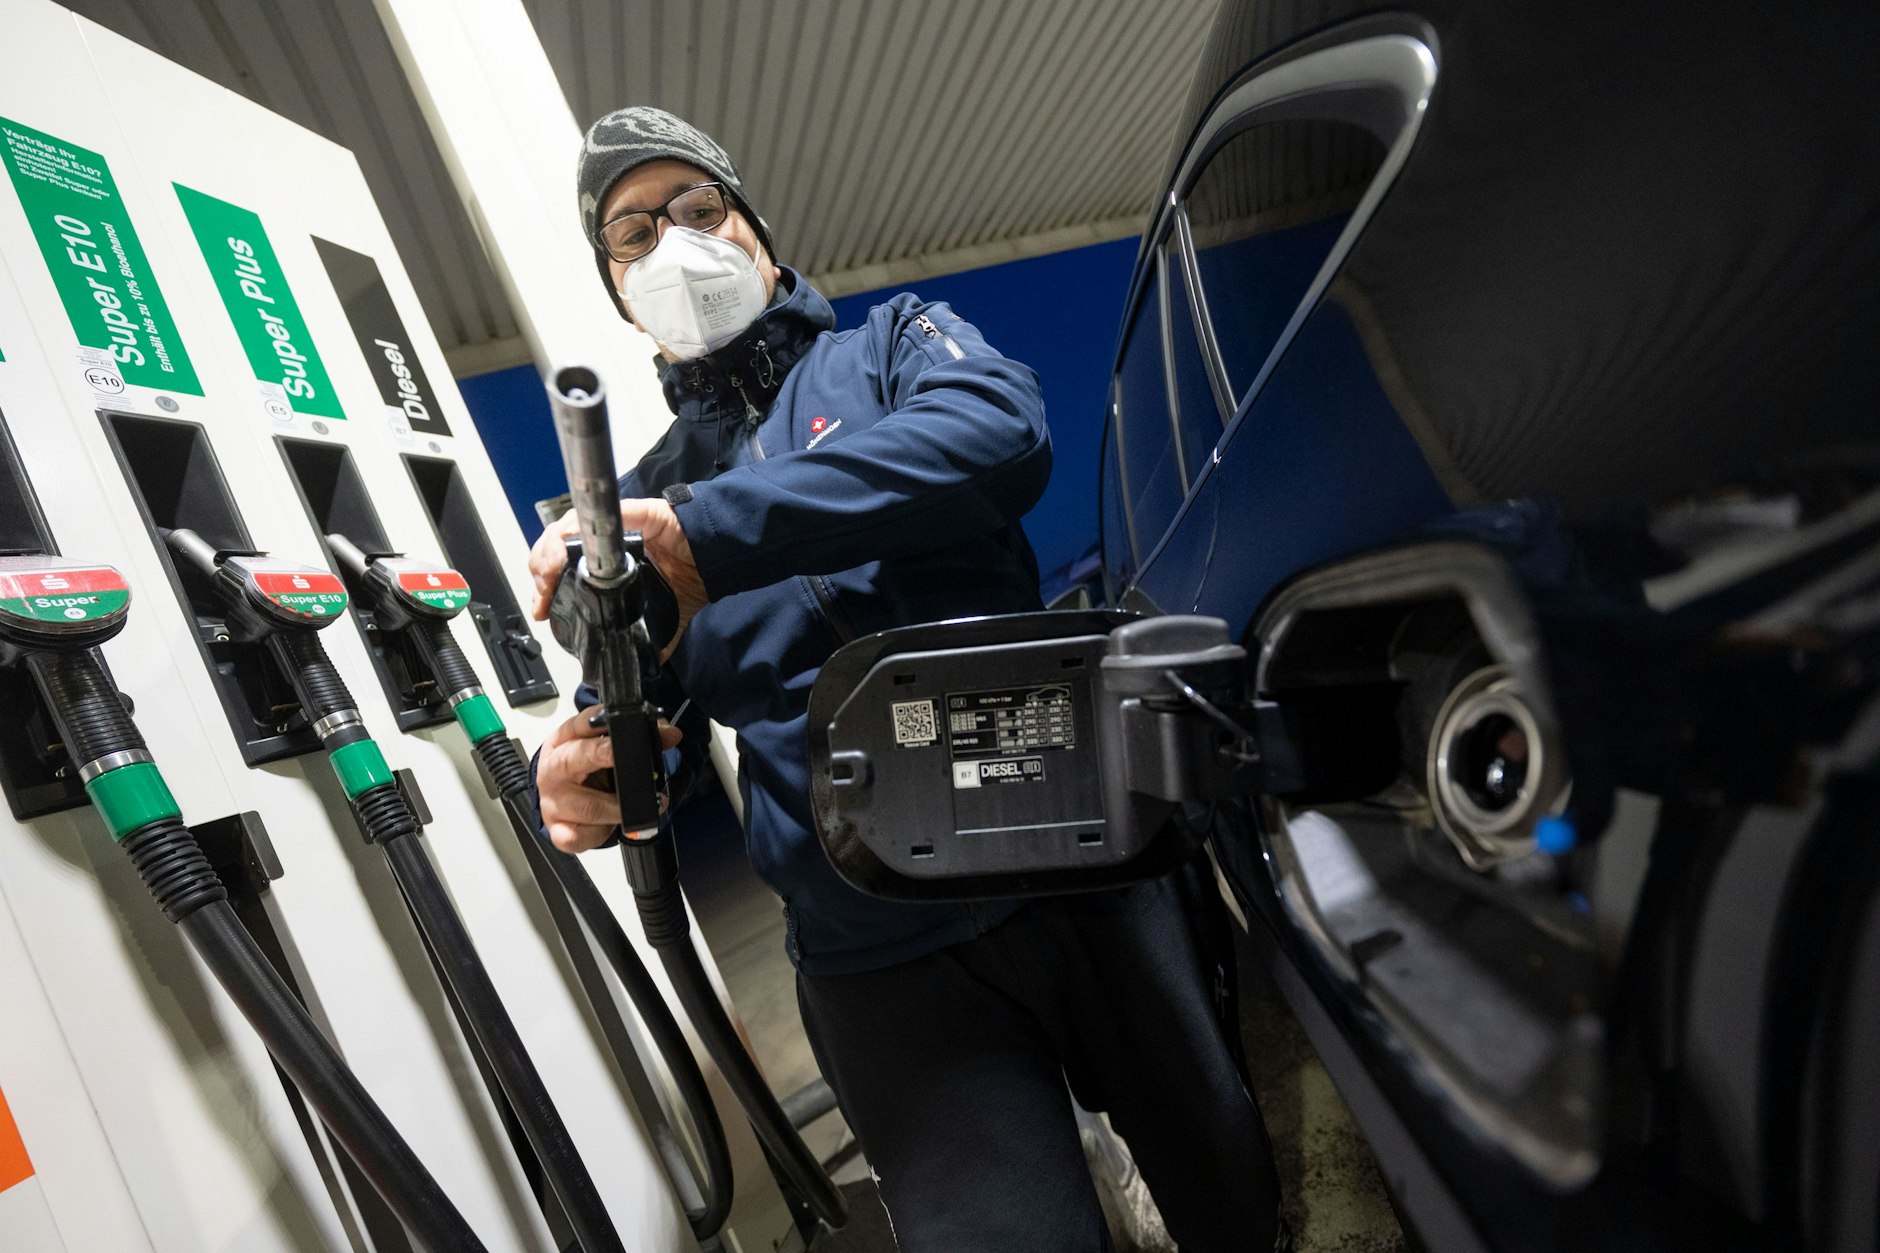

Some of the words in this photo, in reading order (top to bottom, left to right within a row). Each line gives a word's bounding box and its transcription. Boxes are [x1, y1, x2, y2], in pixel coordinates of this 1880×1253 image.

[2, 127, 57, 153] Verträgt
[59, 148, 76, 160] Ihr
[7, 137, 69, 167] Fahrzeug
[71, 161, 102, 177] E10?
[19, 168, 47, 181] Super
[49, 178, 69, 189] Plus
[64, 177, 90, 190] Super
[53, 214, 107, 273] E10
[100, 221, 134, 278] Bioethanol
[227, 237, 275, 304] Plus
[125, 280, 144, 300] 10%
[137, 303, 151, 317] zu
[86, 276, 145, 366] Super
[143, 317, 158, 334] bis
[149, 335, 175, 373] Enthält
[257, 308, 315, 399] Super
[89, 375, 120, 387] E10
[374, 339, 430, 421] Diesel
[271, 406, 287, 415] E5
[35, 596, 97, 608] Super
[281, 595, 317, 605] Super
[319, 594, 342, 603] E10
[418, 591, 446, 600] Super
[447, 590, 468, 598] Plus
[981, 762, 1022, 777] DIESEL
